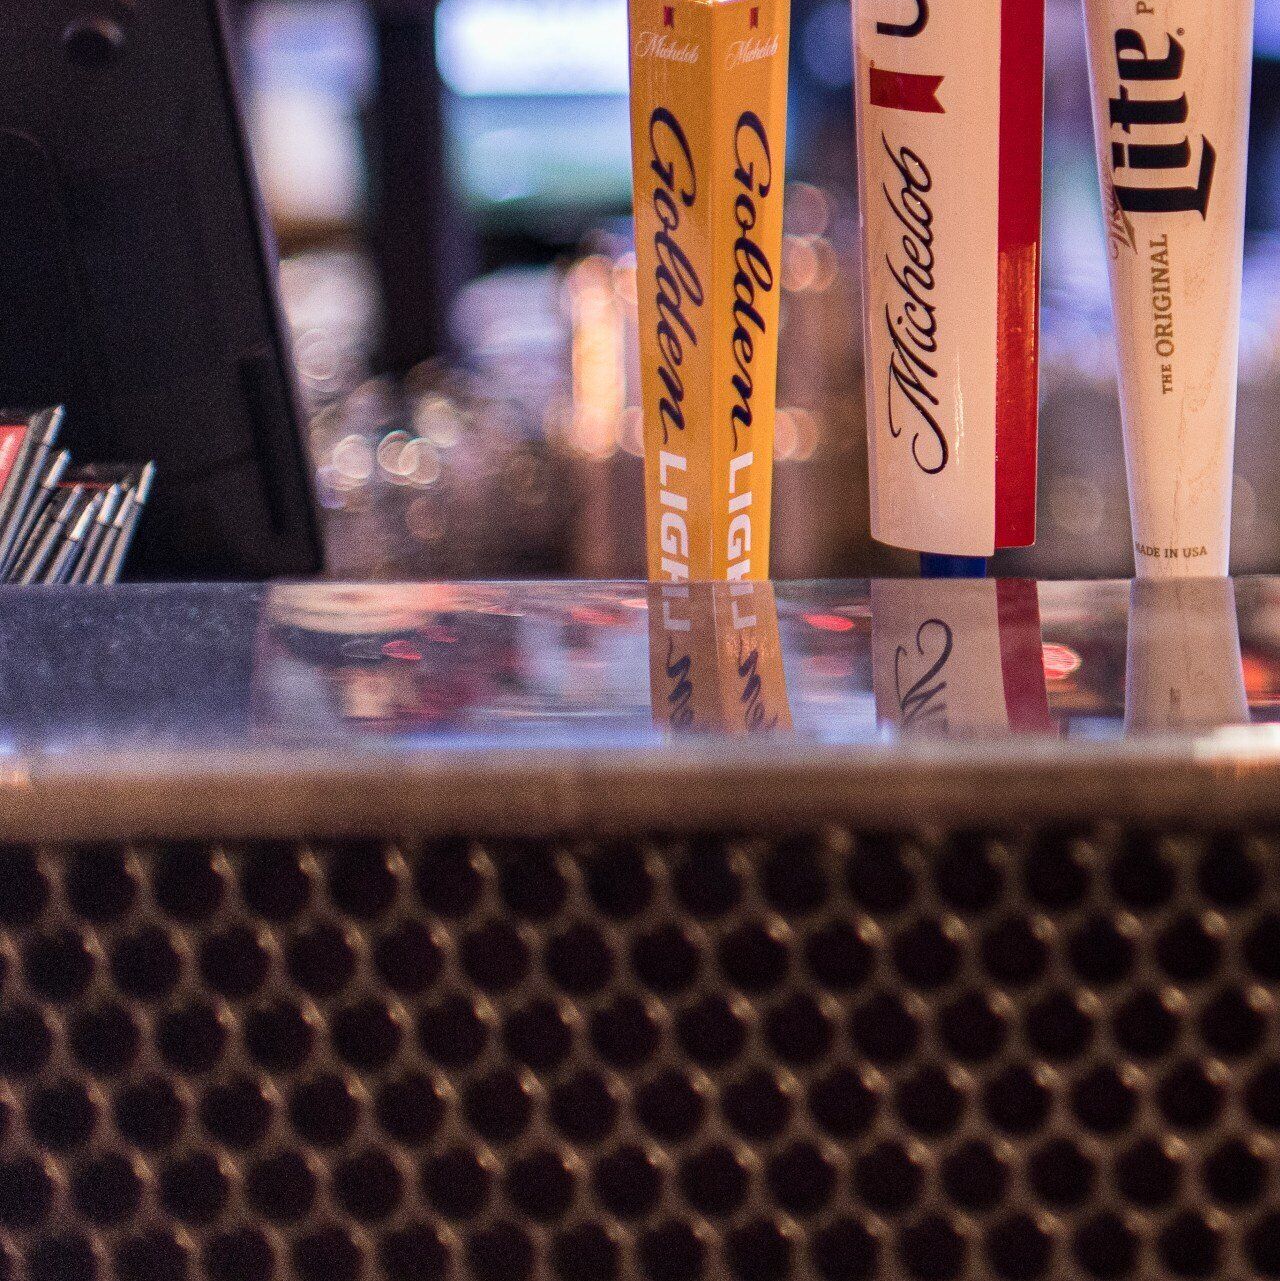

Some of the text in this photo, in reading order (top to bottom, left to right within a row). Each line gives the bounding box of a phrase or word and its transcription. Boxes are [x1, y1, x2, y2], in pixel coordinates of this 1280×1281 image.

[1108, 28, 1216, 221] Lite
[649, 107, 704, 445] Golden
[731, 110, 773, 452] Golden
[881, 130, 950, 476] Michelob
[1149, 233, 1175, 358] ORIGINAL
[1162, 364, 1174, 394] THE
[659, 451, 689, 582] LIGH
[726, 451, 754, 582] LIGH
[1164, 548, 1178, 558] IN
[1182, 545, 1208, 558] USA
